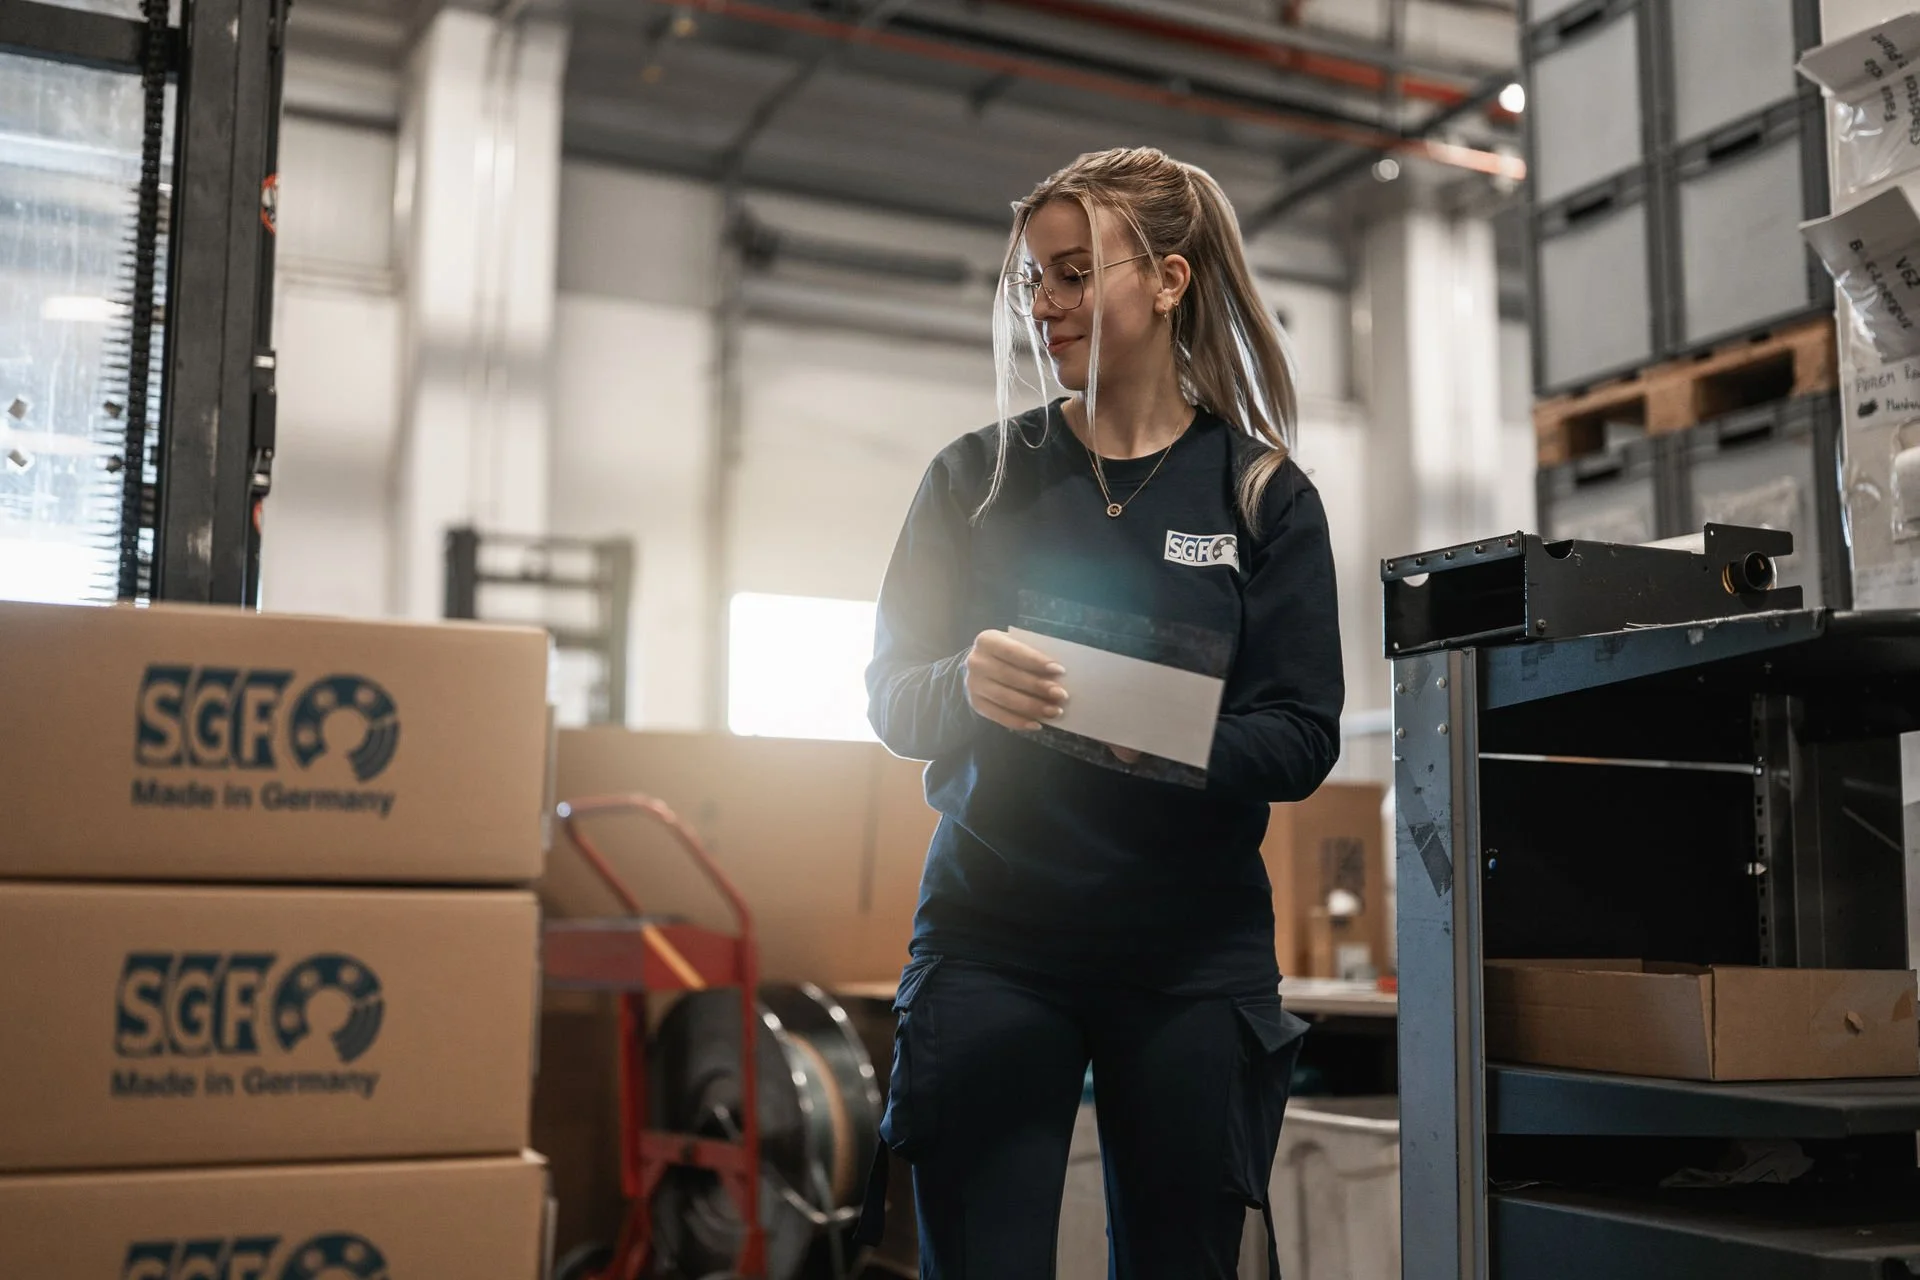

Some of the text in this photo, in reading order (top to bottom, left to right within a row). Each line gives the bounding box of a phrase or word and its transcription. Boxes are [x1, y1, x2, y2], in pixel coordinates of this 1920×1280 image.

[1168, 533, 1215, 562] SGF
[135, 664, 296, 770] SGF
[131, 778, 396, 819] Made in Germany
[115, 952, 279, 1058] SGF
[110, 1066, 381, 1101] Made in Germany
